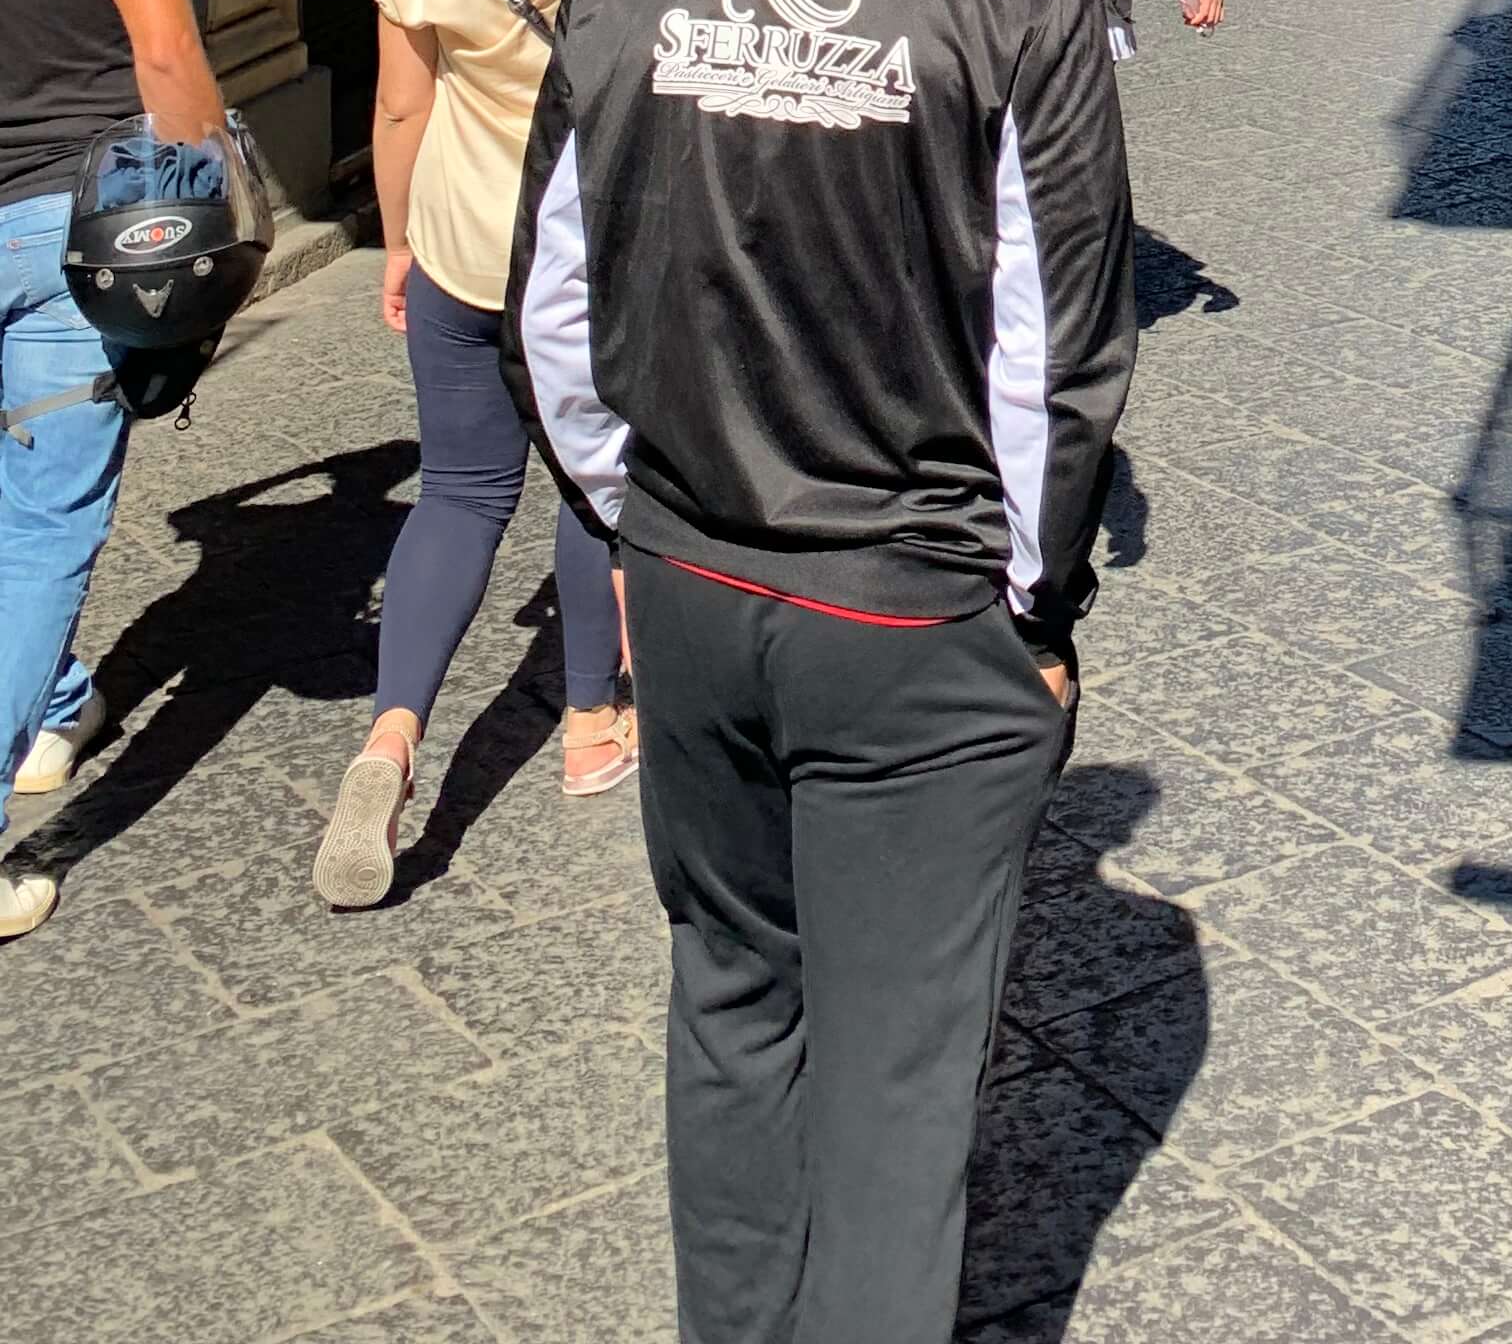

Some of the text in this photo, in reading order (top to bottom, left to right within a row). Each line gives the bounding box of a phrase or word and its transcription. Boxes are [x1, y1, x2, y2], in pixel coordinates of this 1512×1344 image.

[654, 8, 916, 94] SFERRUZZA
[656, 62, 743, 83] Pasticceri
[828, 80, 911, 107] Artigiani
[122, 225, 184, 244] SUOMY
